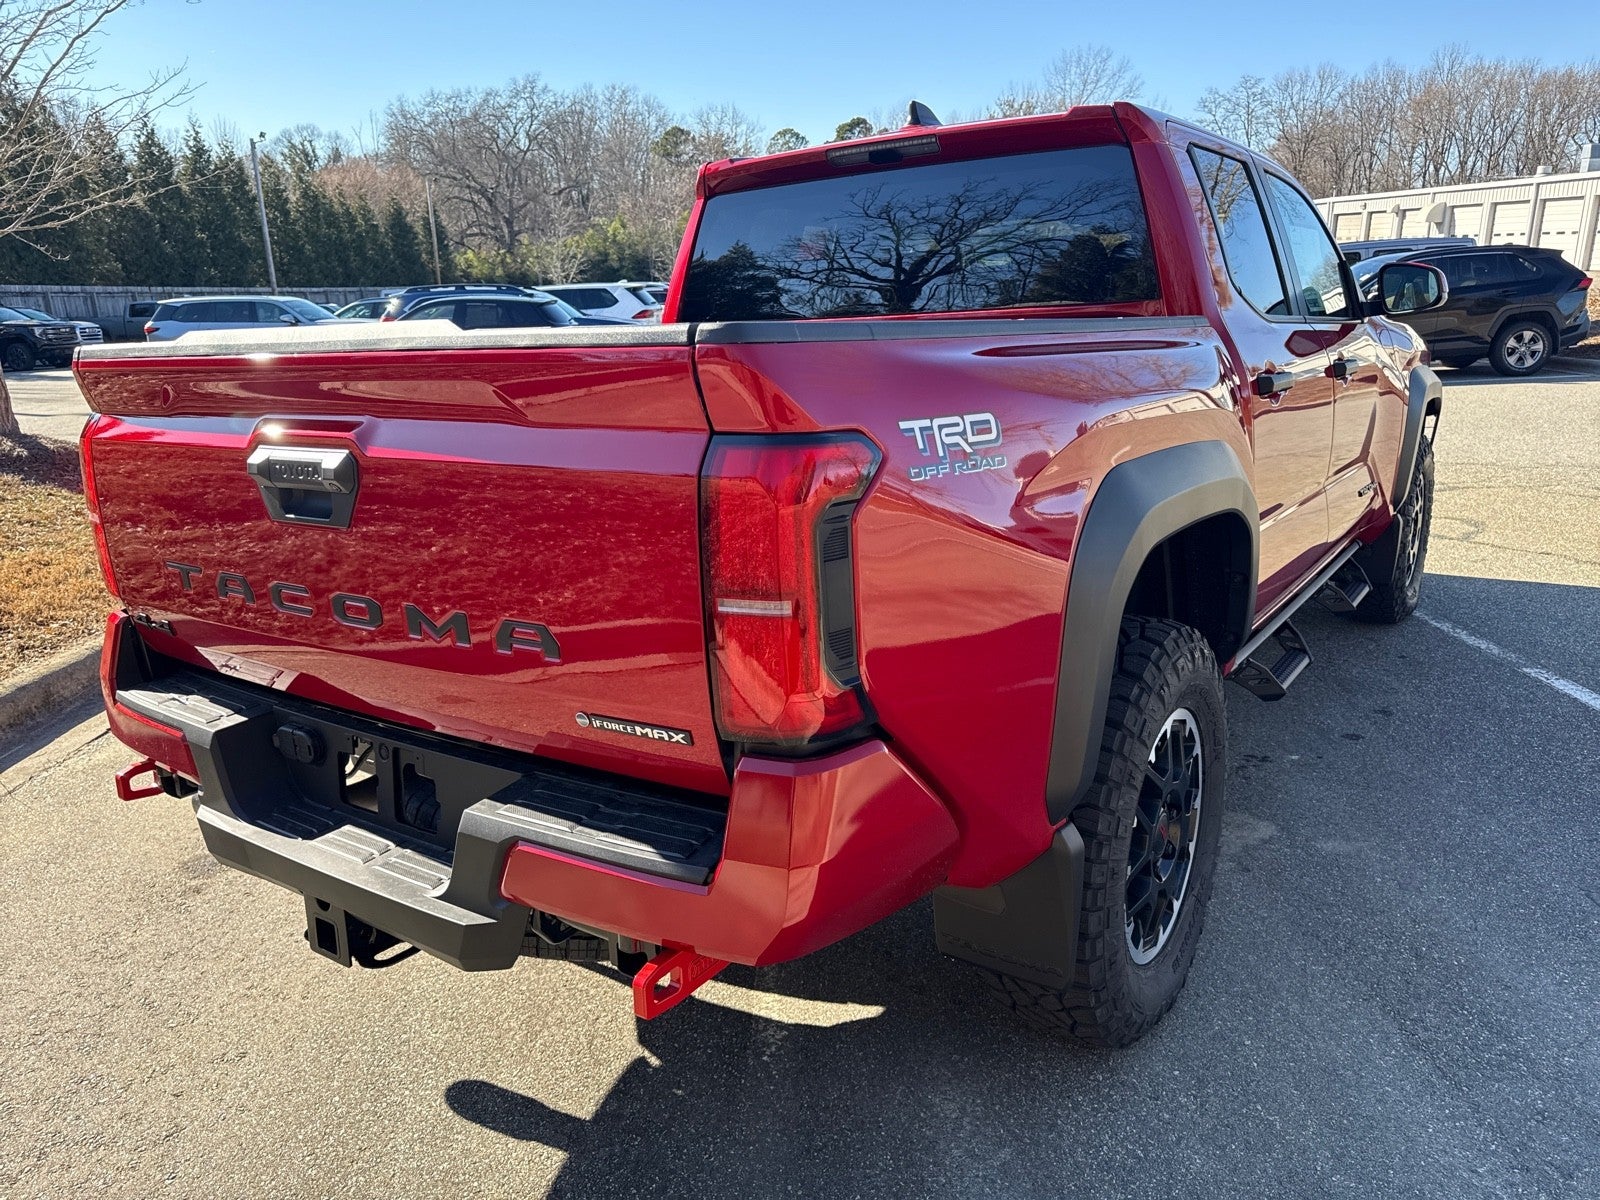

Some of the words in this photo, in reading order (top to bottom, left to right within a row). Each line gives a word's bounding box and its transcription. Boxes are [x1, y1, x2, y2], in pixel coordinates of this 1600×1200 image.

[898, 412, 1002, 462] TRD
[271, 462, 322, 481] TOYOTA
[908, 463, 950, 481] OFF
[954, 455, 1007, 475] ROAD
[165, 560, 562, 664] TACOMA
